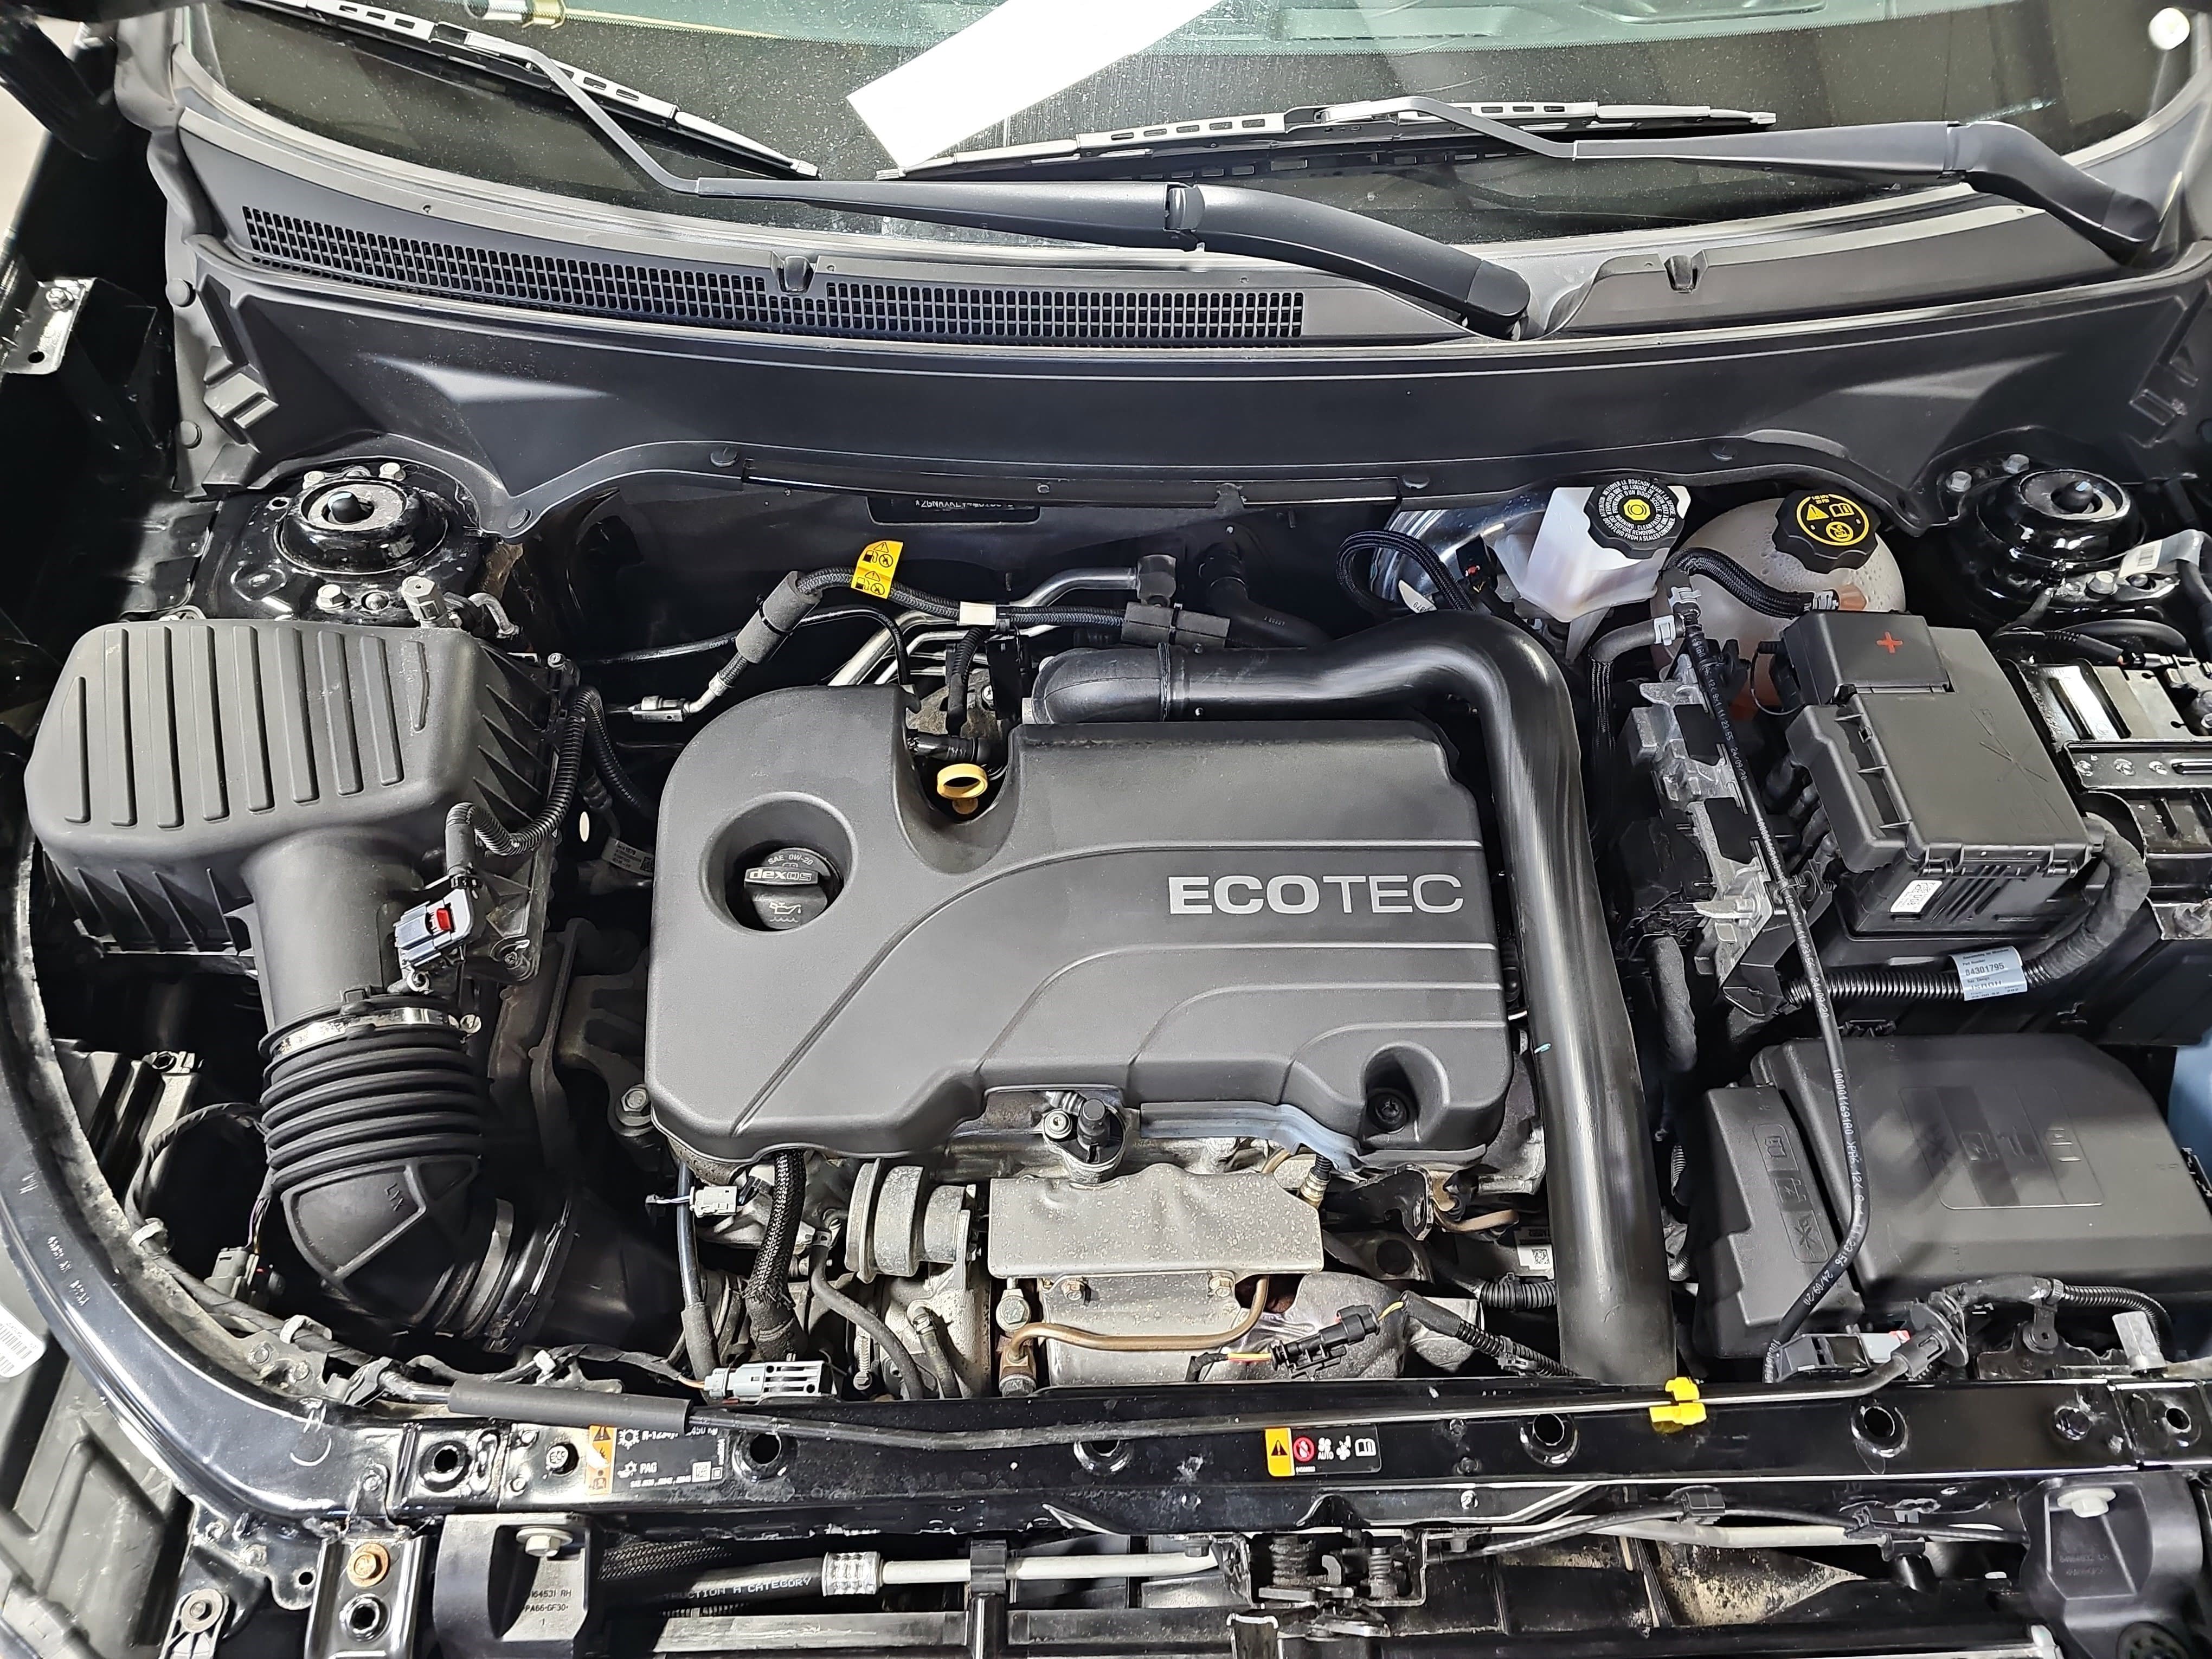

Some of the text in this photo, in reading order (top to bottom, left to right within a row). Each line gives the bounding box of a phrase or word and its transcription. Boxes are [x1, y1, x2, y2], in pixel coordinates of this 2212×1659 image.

[1628, 479, 1650, 487] BOUCHON
[1650, 484, 1664, 496] AVANT
[1637, 490, 1651, 499] BIDON
[1624, 533, 1638, 541] FROM
[1642, 532, 1661, 542] SEALED
[768, 854, 814, 865] SAE 0W-20
[749, 869, 812, 881] dexos
[1168, 874, 1464, 915] ECOTEC
[1317, 1451, 1334, 1460] AUTO
[640, 1462, 658, 1474] PAG
[732, 1585, 742, 1594] A
[748, 1577, 812, 1593] CATEGORY
